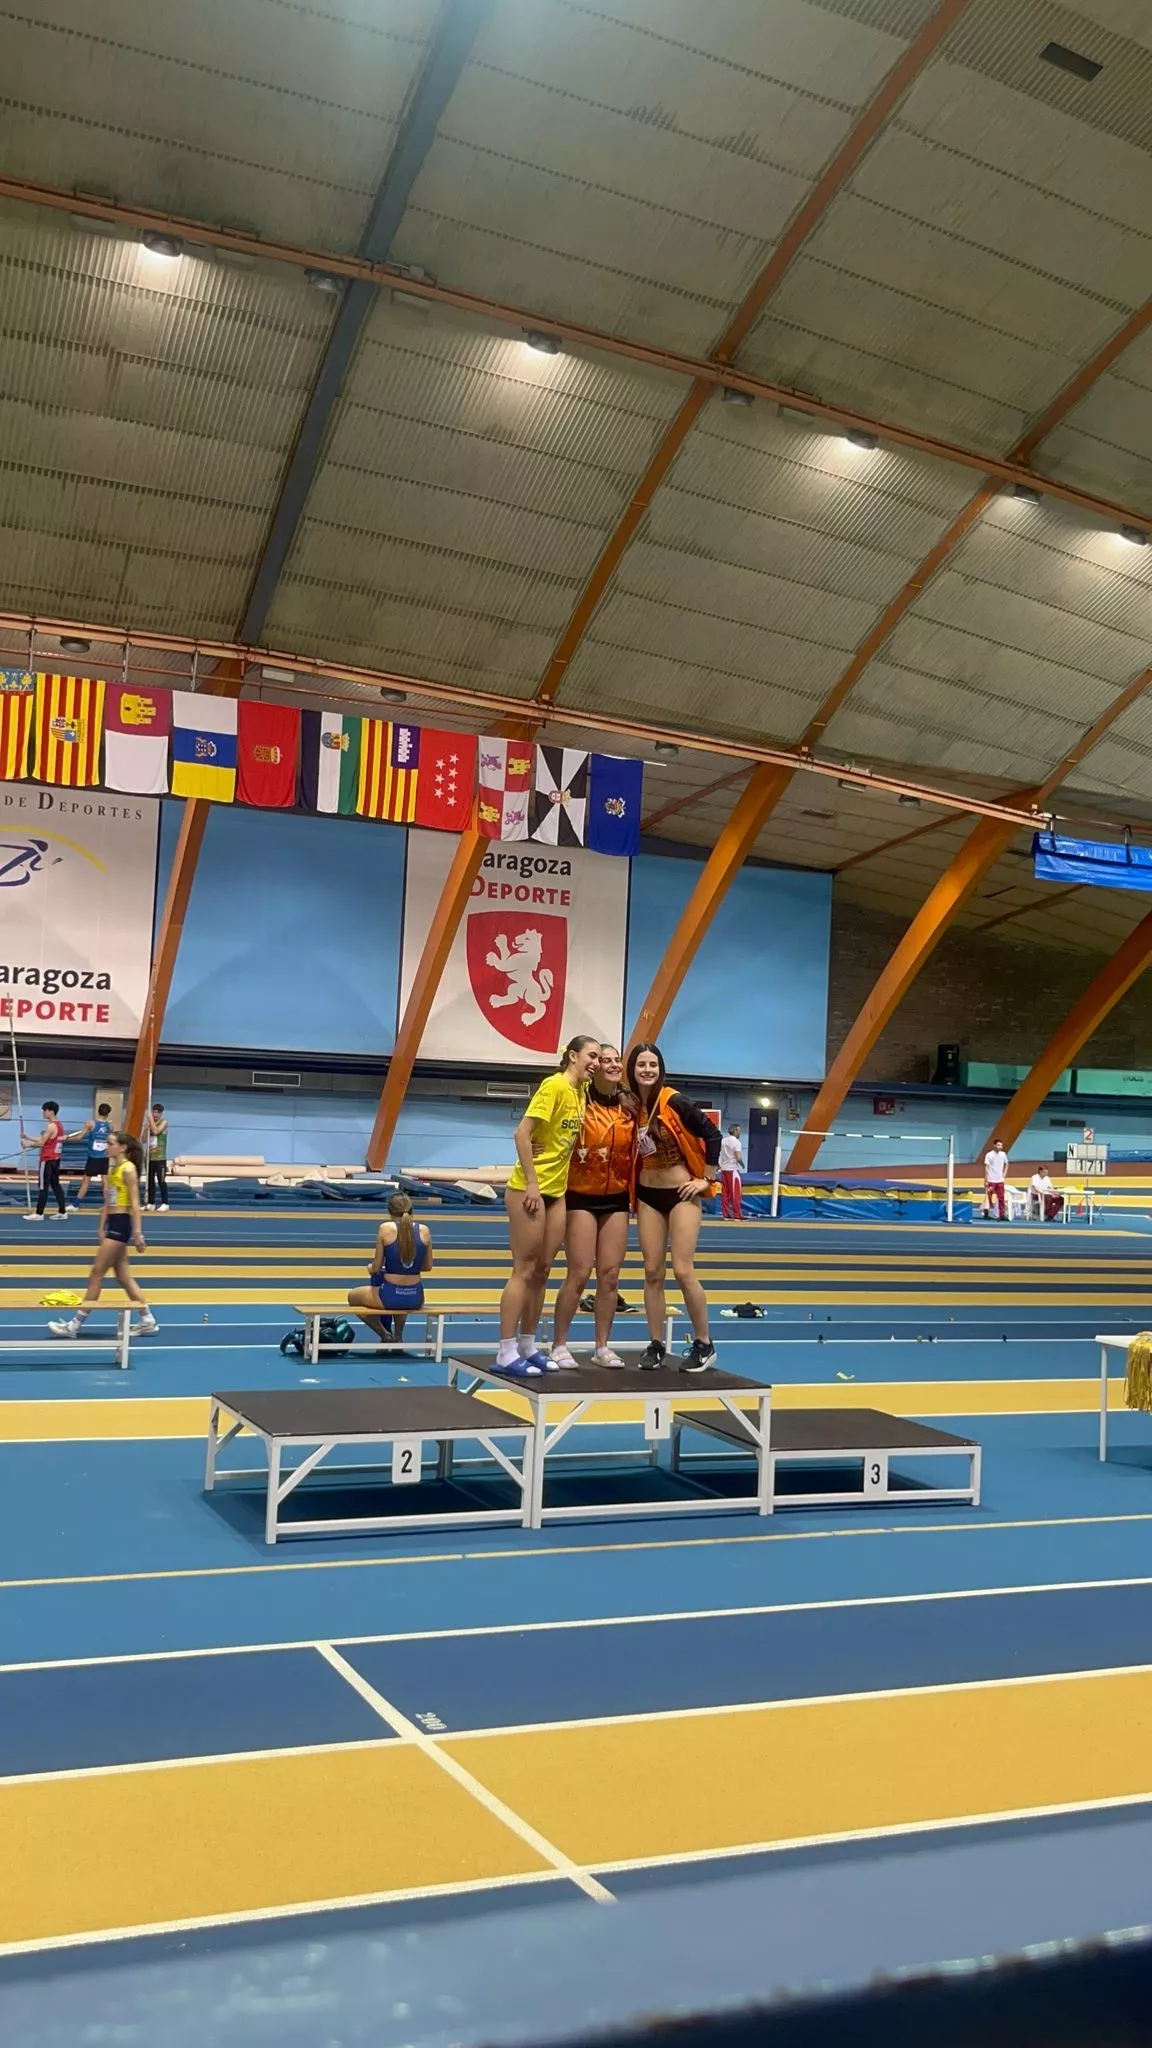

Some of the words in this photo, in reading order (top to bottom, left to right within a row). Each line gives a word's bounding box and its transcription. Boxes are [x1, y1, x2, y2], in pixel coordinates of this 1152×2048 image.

[4, 795, 27, 808] DE
[38, 791, 143, 820] DEPORTES
[480, 852, 571, 878] aragoza
[0, 965, 111, 995] aragoza
[0, 998, 110, 1023] EPORTE
[1085, 1128, 1093, 1141] 2
[654, 1407, 660, 1430] 1
[401, 1449, 413, 1474] 2
[871, 1463, 881, 1485] 3
